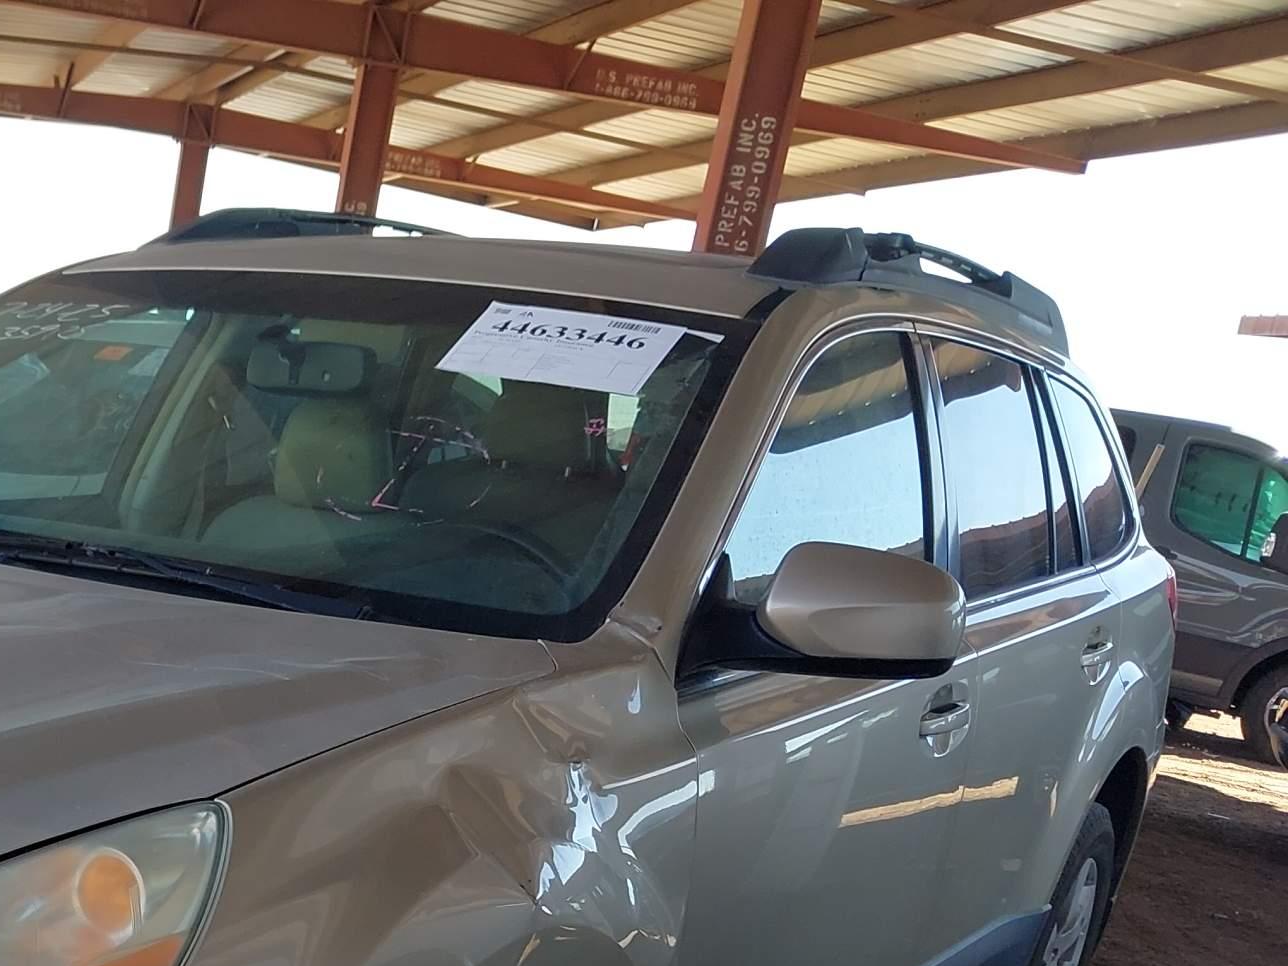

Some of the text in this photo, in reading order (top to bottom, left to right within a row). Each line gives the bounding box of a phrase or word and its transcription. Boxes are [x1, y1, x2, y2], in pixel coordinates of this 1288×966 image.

[626, 73, 673, 92] PREFAB
[715, 112, 760, 247] PREFAB INC.
[491, 319, 649, 350] 44633446
